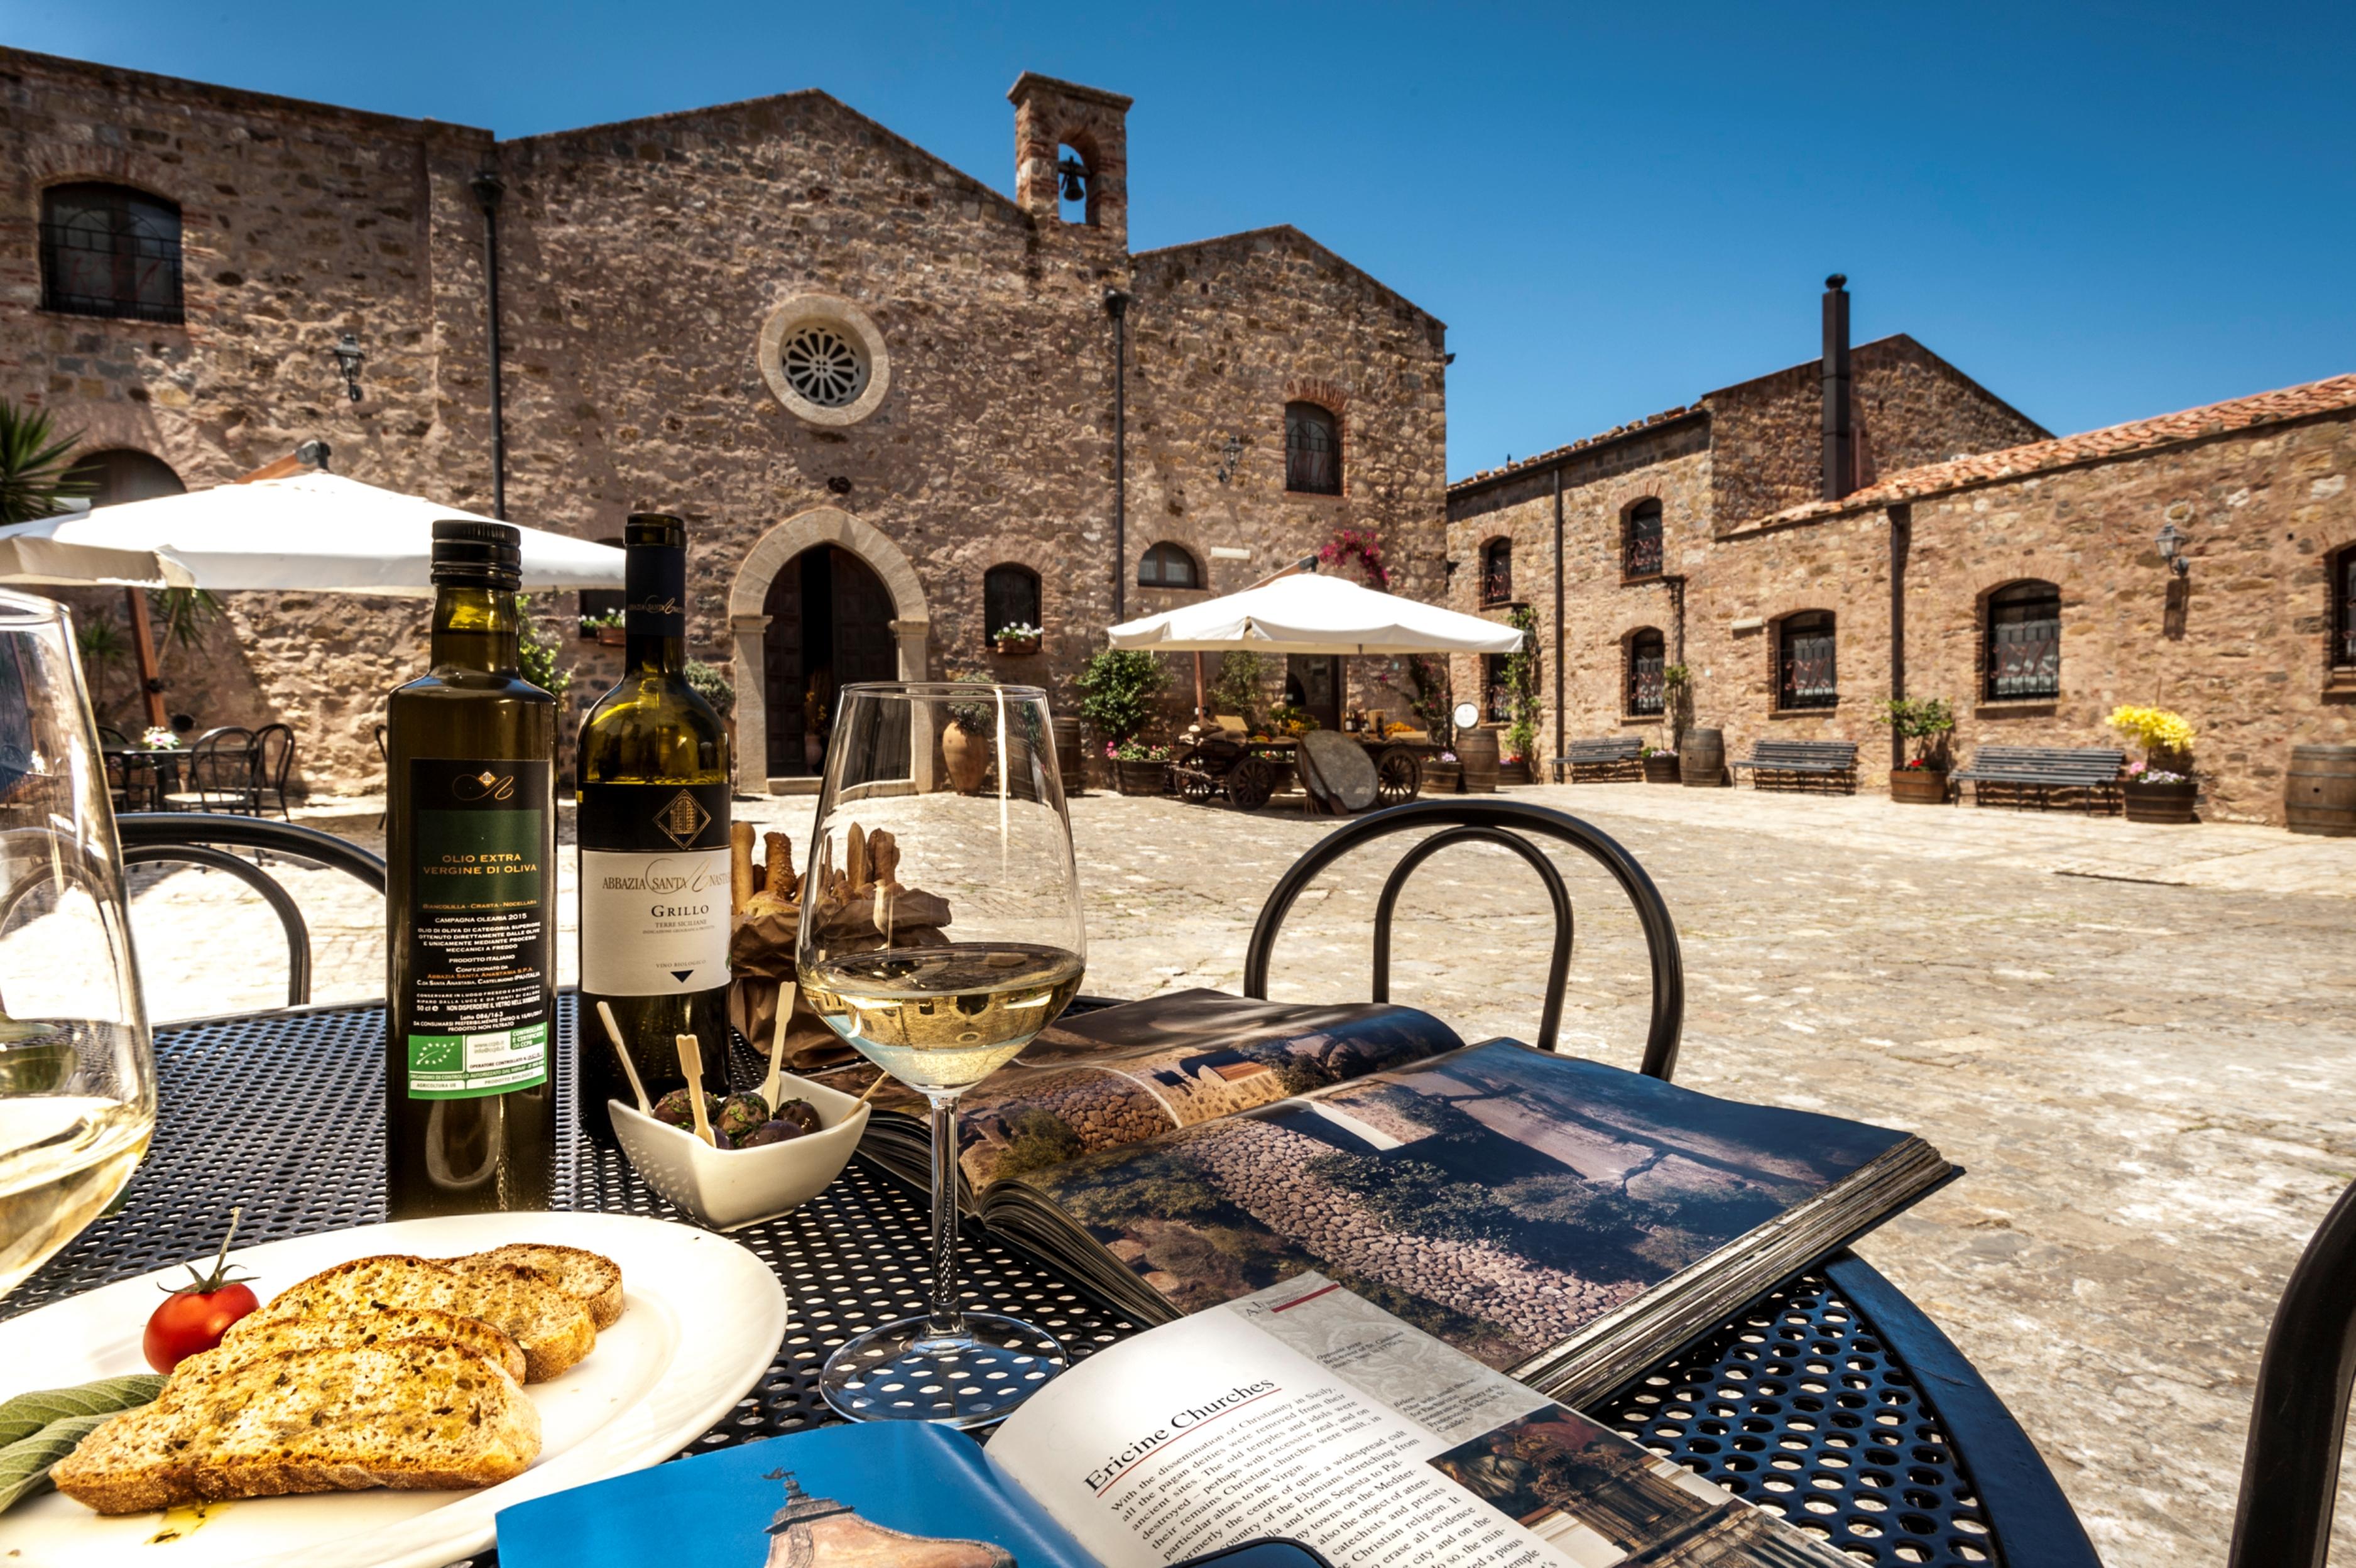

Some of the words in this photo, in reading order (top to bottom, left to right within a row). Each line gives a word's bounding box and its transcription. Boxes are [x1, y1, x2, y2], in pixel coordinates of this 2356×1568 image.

[480, 854, 521, 863] EXTRA
[504, 864, 537, 873] OLIVA
[603, 876, 646, 890] ABBAZIA
[511, 922, 540, 930] SUPERIORE
[651, 905, 709, 917] GRILLO
[1083, 1429, 1169, 1493] Ericine
[1170, 1380, 1275, 1429] Churches
[1110, 1490, 1138, 1511] With
[1138, 1476, 1156, 1489] the
[1158, 1435, 1224, 1476] dissemination
[1226, 1427, 1238, 1436] of
[1238, 1403, 1292, 1428] Christianity
[1305, 1388, 1336, 1400] Sicily,
[1122, 1506, 1137, 1522] all
[1138, 1492, 1156, 1506] the
[1158, 1469, 1190, 1493] pagan
[1192, 1449, 1226, 1469] deities
[1229, 1434, 1251, 1447] were
[1255, 1412, 1297, 1434] removed
[1298, 1403, 1323, 1415] from
[1323, 1394, 1346, 1405] their
[1132, 1497, 1170, 1532] ancient
[1172, 1479, 1201, 1497] sites.
[1201, 1463, 1224, 1476] The
[1227, 1451, 1245, 1463] old
[1246, 1432, 1285, 1452] temples
[1288, 1420, 1307, 1432] and
[1309, 1412, 1333, 1423] idols
[1334, 1402, 1358, 1412] were
[1142, 1498, 1191, 1540] destroyed
[1203, 1469, 1242, 1495] perhaps
[1244, 1455, 1267, 1467] with
[1268, 1432, 1312, 1456] excessive
[1316, 1422, 1338, 1433] zeal,
[1339, 1413, 1356, 1424] and
[1152, 1526, 1177, 1550] their
[1179, 1496, 1222, 1527] remains
[1223, 1467, 1271, 1496] Christian
[1273, 1445, 1316, 1467] churches
[1318, 1432, 1342, 1444] were
[1341, 1422, 1370, 1433] built,
[1224, 1515, 1244, 1529] the
[1246, 1494, 1279, 1516] centre
[1281, 1484, 1293, 1495] of
[1295, 1471, 1321, 1487] quite
[1333, 1438, 1387, 1466] widespread
[1388, 1430, 1407, 1441] cult
[1263, 1511, 1275, 1523] of
[1276, 1502, 1295, 1515] the
[1294, 1476, 1344, 1503] Elymians
[1344, 1449, 1397, 1476] (stretching
[1394, 1439, 1420, 1451] from
[1283, 1512, 1304, 1529] and
[1303, 1498, 1332, 1516] from
[1330, 1477, 1371, 1500] Segesta
[1382, 1460, 1403, 1473] Pal-
[1309, 1509, 1343, 1530] towns
[1343, 1500, 1358, 1510] on
[1357, 1491, 1375, 1501] the
[1373, 1470, 1416, 1492] Mediter-
[1162, 1518, 1212, 1562] particular
[1213, 1501, 1242, 1520] altars
[1241, 1493, 1255, 1501] to
[1253, 1483, 1272, 1494] the
[1270, 1463, 1307, 1482] Virgin.
[1317, 1529, 1341, 1545] also
[1339, 1518, 1359, 1530] the
[1359, 1499, 1391, 1519] object
[1390, 1491, 1403, 1501] of
[1402, 1479, 1430, 1495] atten-
[1332, 1521, 1387, 1555] catechists
[1388, 1505, 1409, 1520] and
[1410, 1488, 1446, 1510] priests
[1351, 1528, 1404, 1562] Christian
[1405, 1505, 1449, 1529] religion.
[1448, 1496, 1461, 1505] It
[1382, 1543, 1412, 1564] erase
[1413, 1530, 1429, 1544] all
[1431, 1507, 1476, 1533] evidence
[1412, 1549, 1434, 1565] city
[1436, 1534, 1457, 1550] and
[1458, 1527, 1473, 1537] on
[1472, 1517, 1492, 1528] the
[1446, 1554, 1465, 1564] so,
[1462, 1542, 1481, 1554] the
[1481, 1529, 1505, 1544] min-
[1494, 1538, 1524, 1559] pious
[1503, 1550, 1541, 1568] temple
